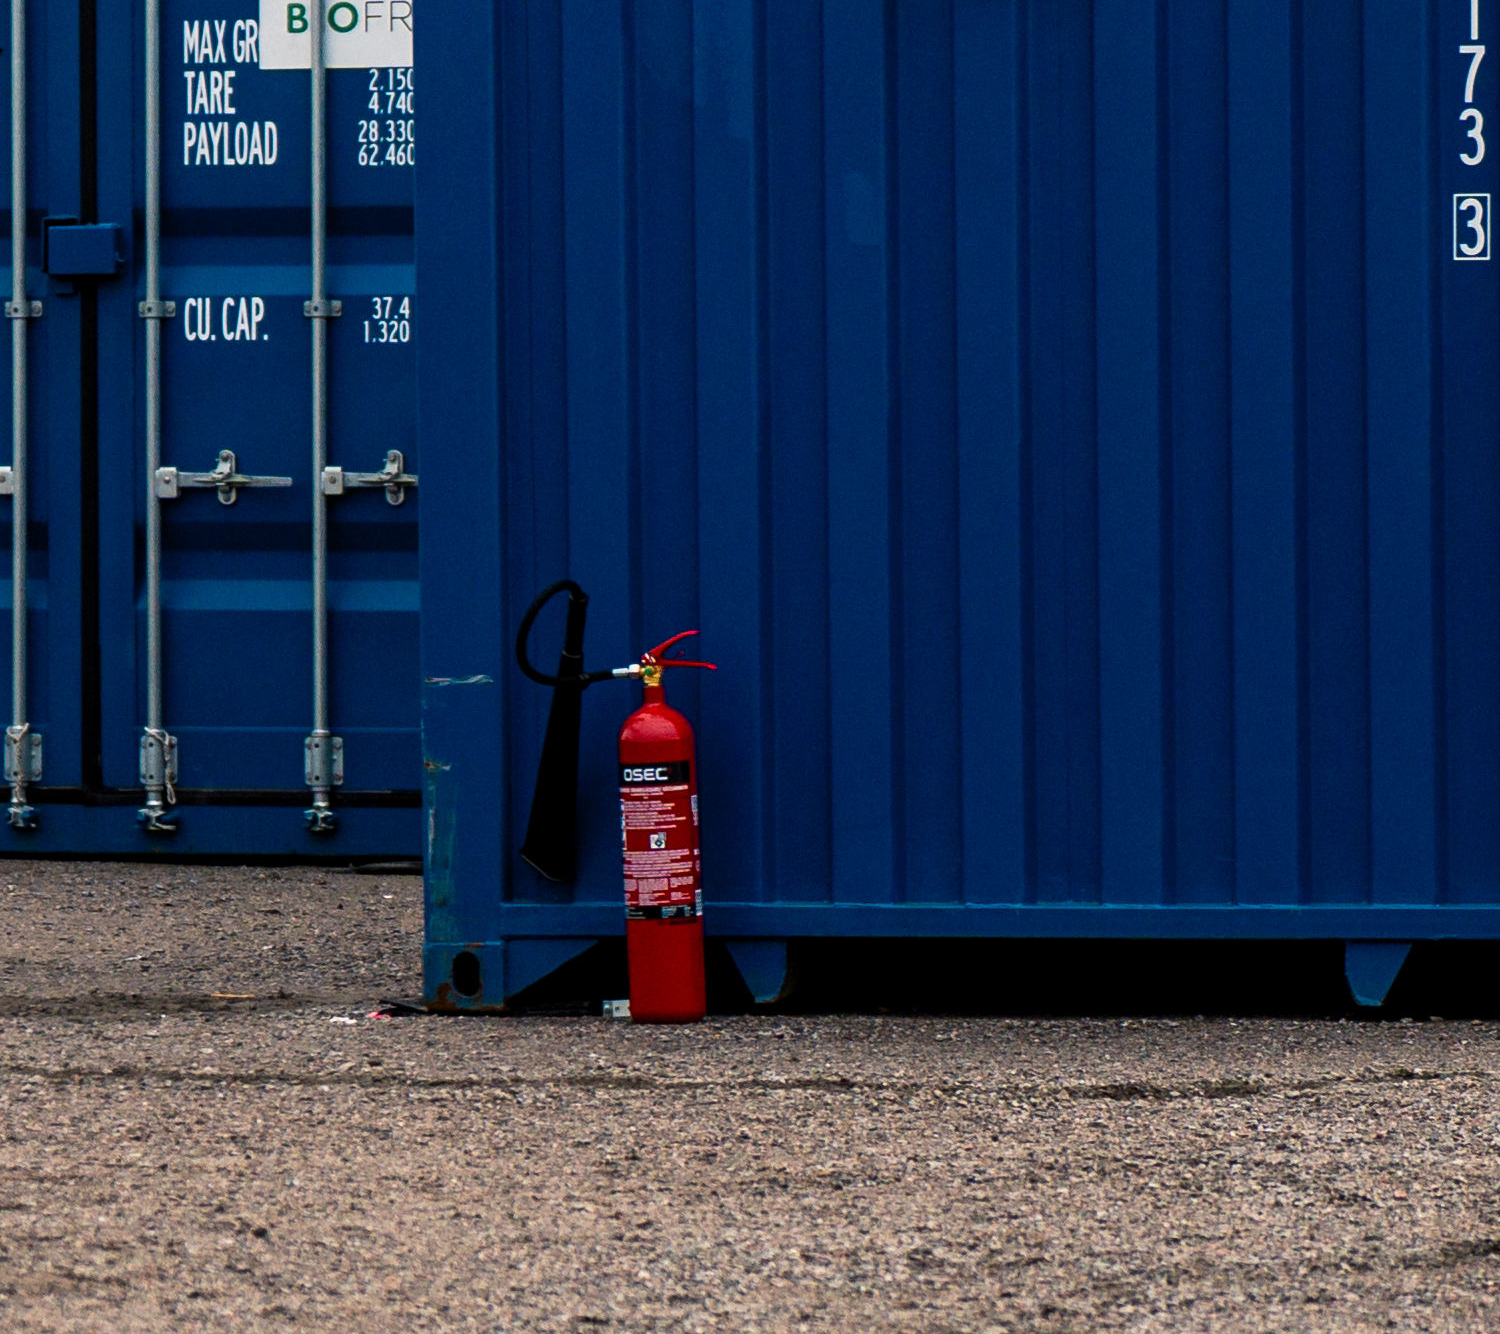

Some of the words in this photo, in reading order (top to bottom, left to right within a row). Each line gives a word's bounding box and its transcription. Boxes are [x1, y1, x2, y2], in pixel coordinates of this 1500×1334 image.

[183, 19, 226, 64] MAX
[183, 70, 236, 114] TARE
[183, 121, 278, 165] PAYLOAD
[1459, 197, 1486, 256] 3
[184, 297, 217, 341] CU.
[222, 296, 269, 341] CAP.
[371, 296, 410, 319] 37.4
[363, 319, 410, 343] 1.320
